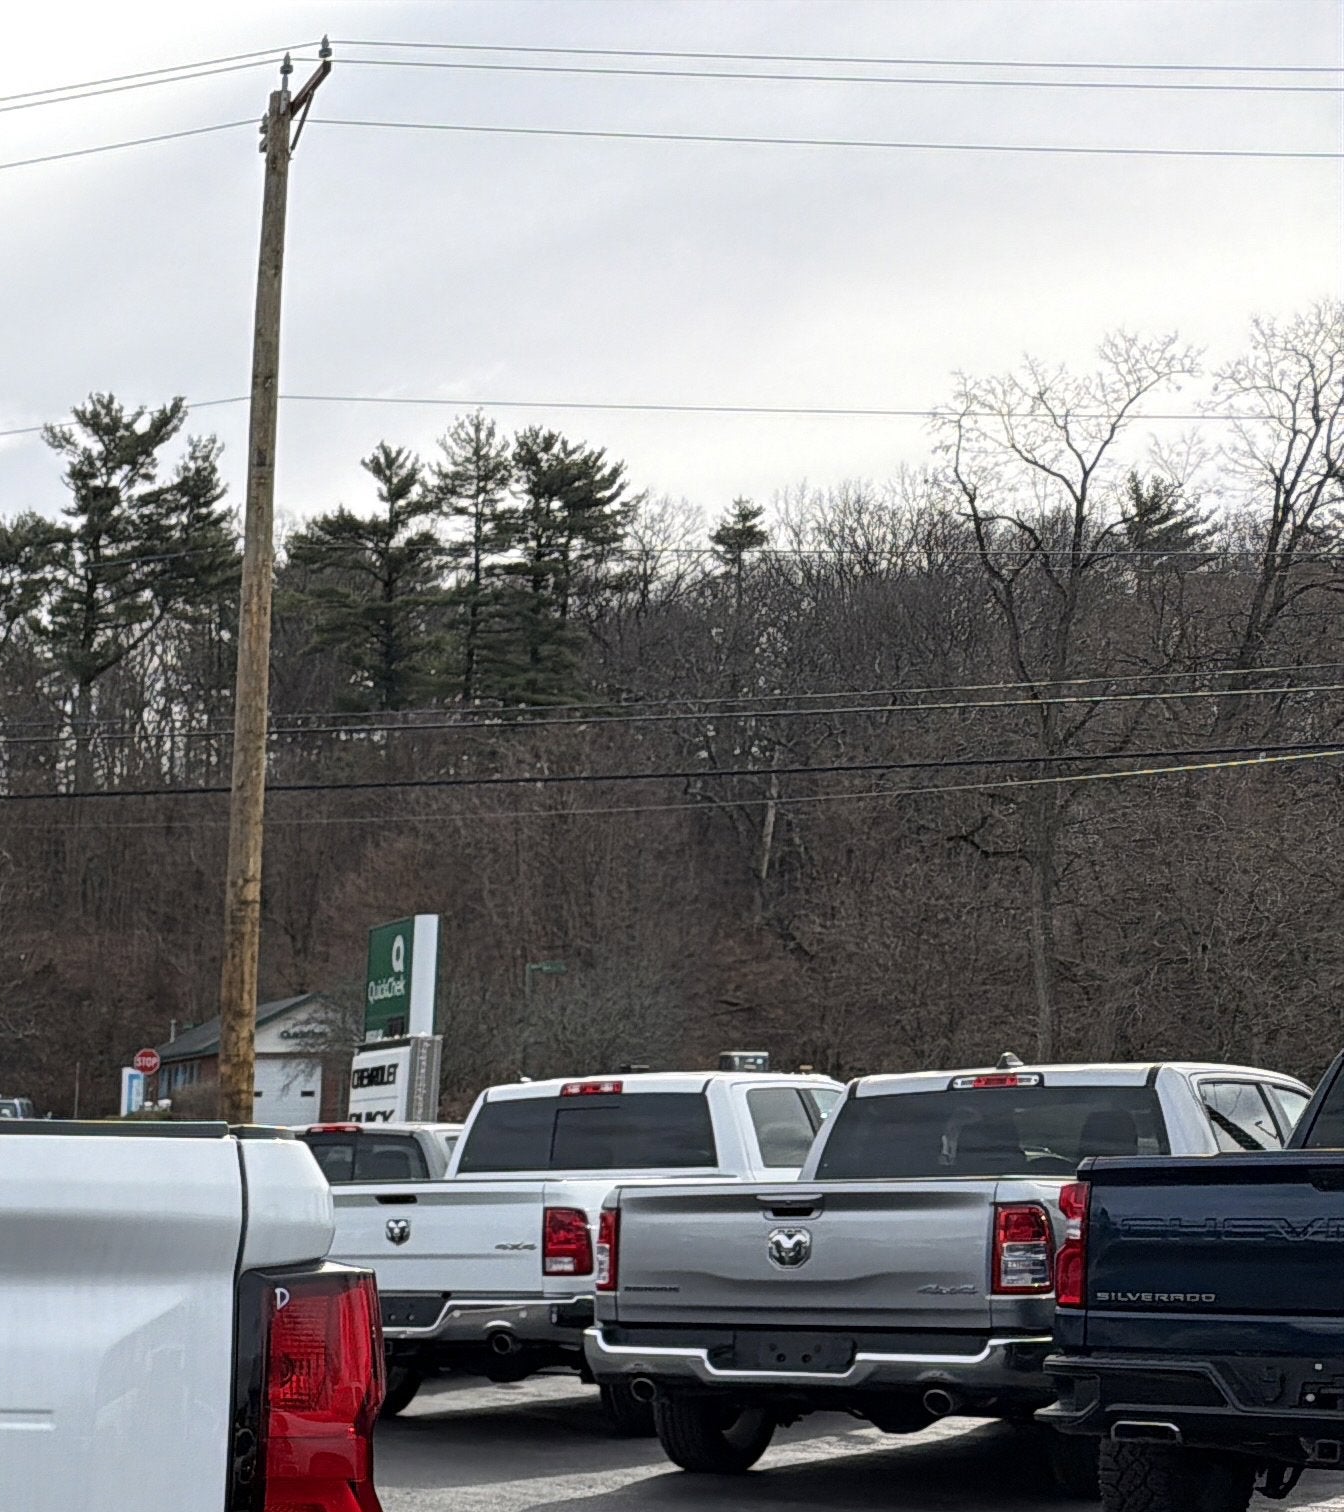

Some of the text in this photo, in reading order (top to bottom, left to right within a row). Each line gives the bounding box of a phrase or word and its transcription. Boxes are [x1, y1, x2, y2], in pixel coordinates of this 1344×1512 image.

[368, 976, 405, 1004] QuickChek
[136, 1056, 159, 1067] STOP
[352, 1063, 399, 1089] CHEVROLET
[1096, 1292, 1216, 1302] SILVERADO
